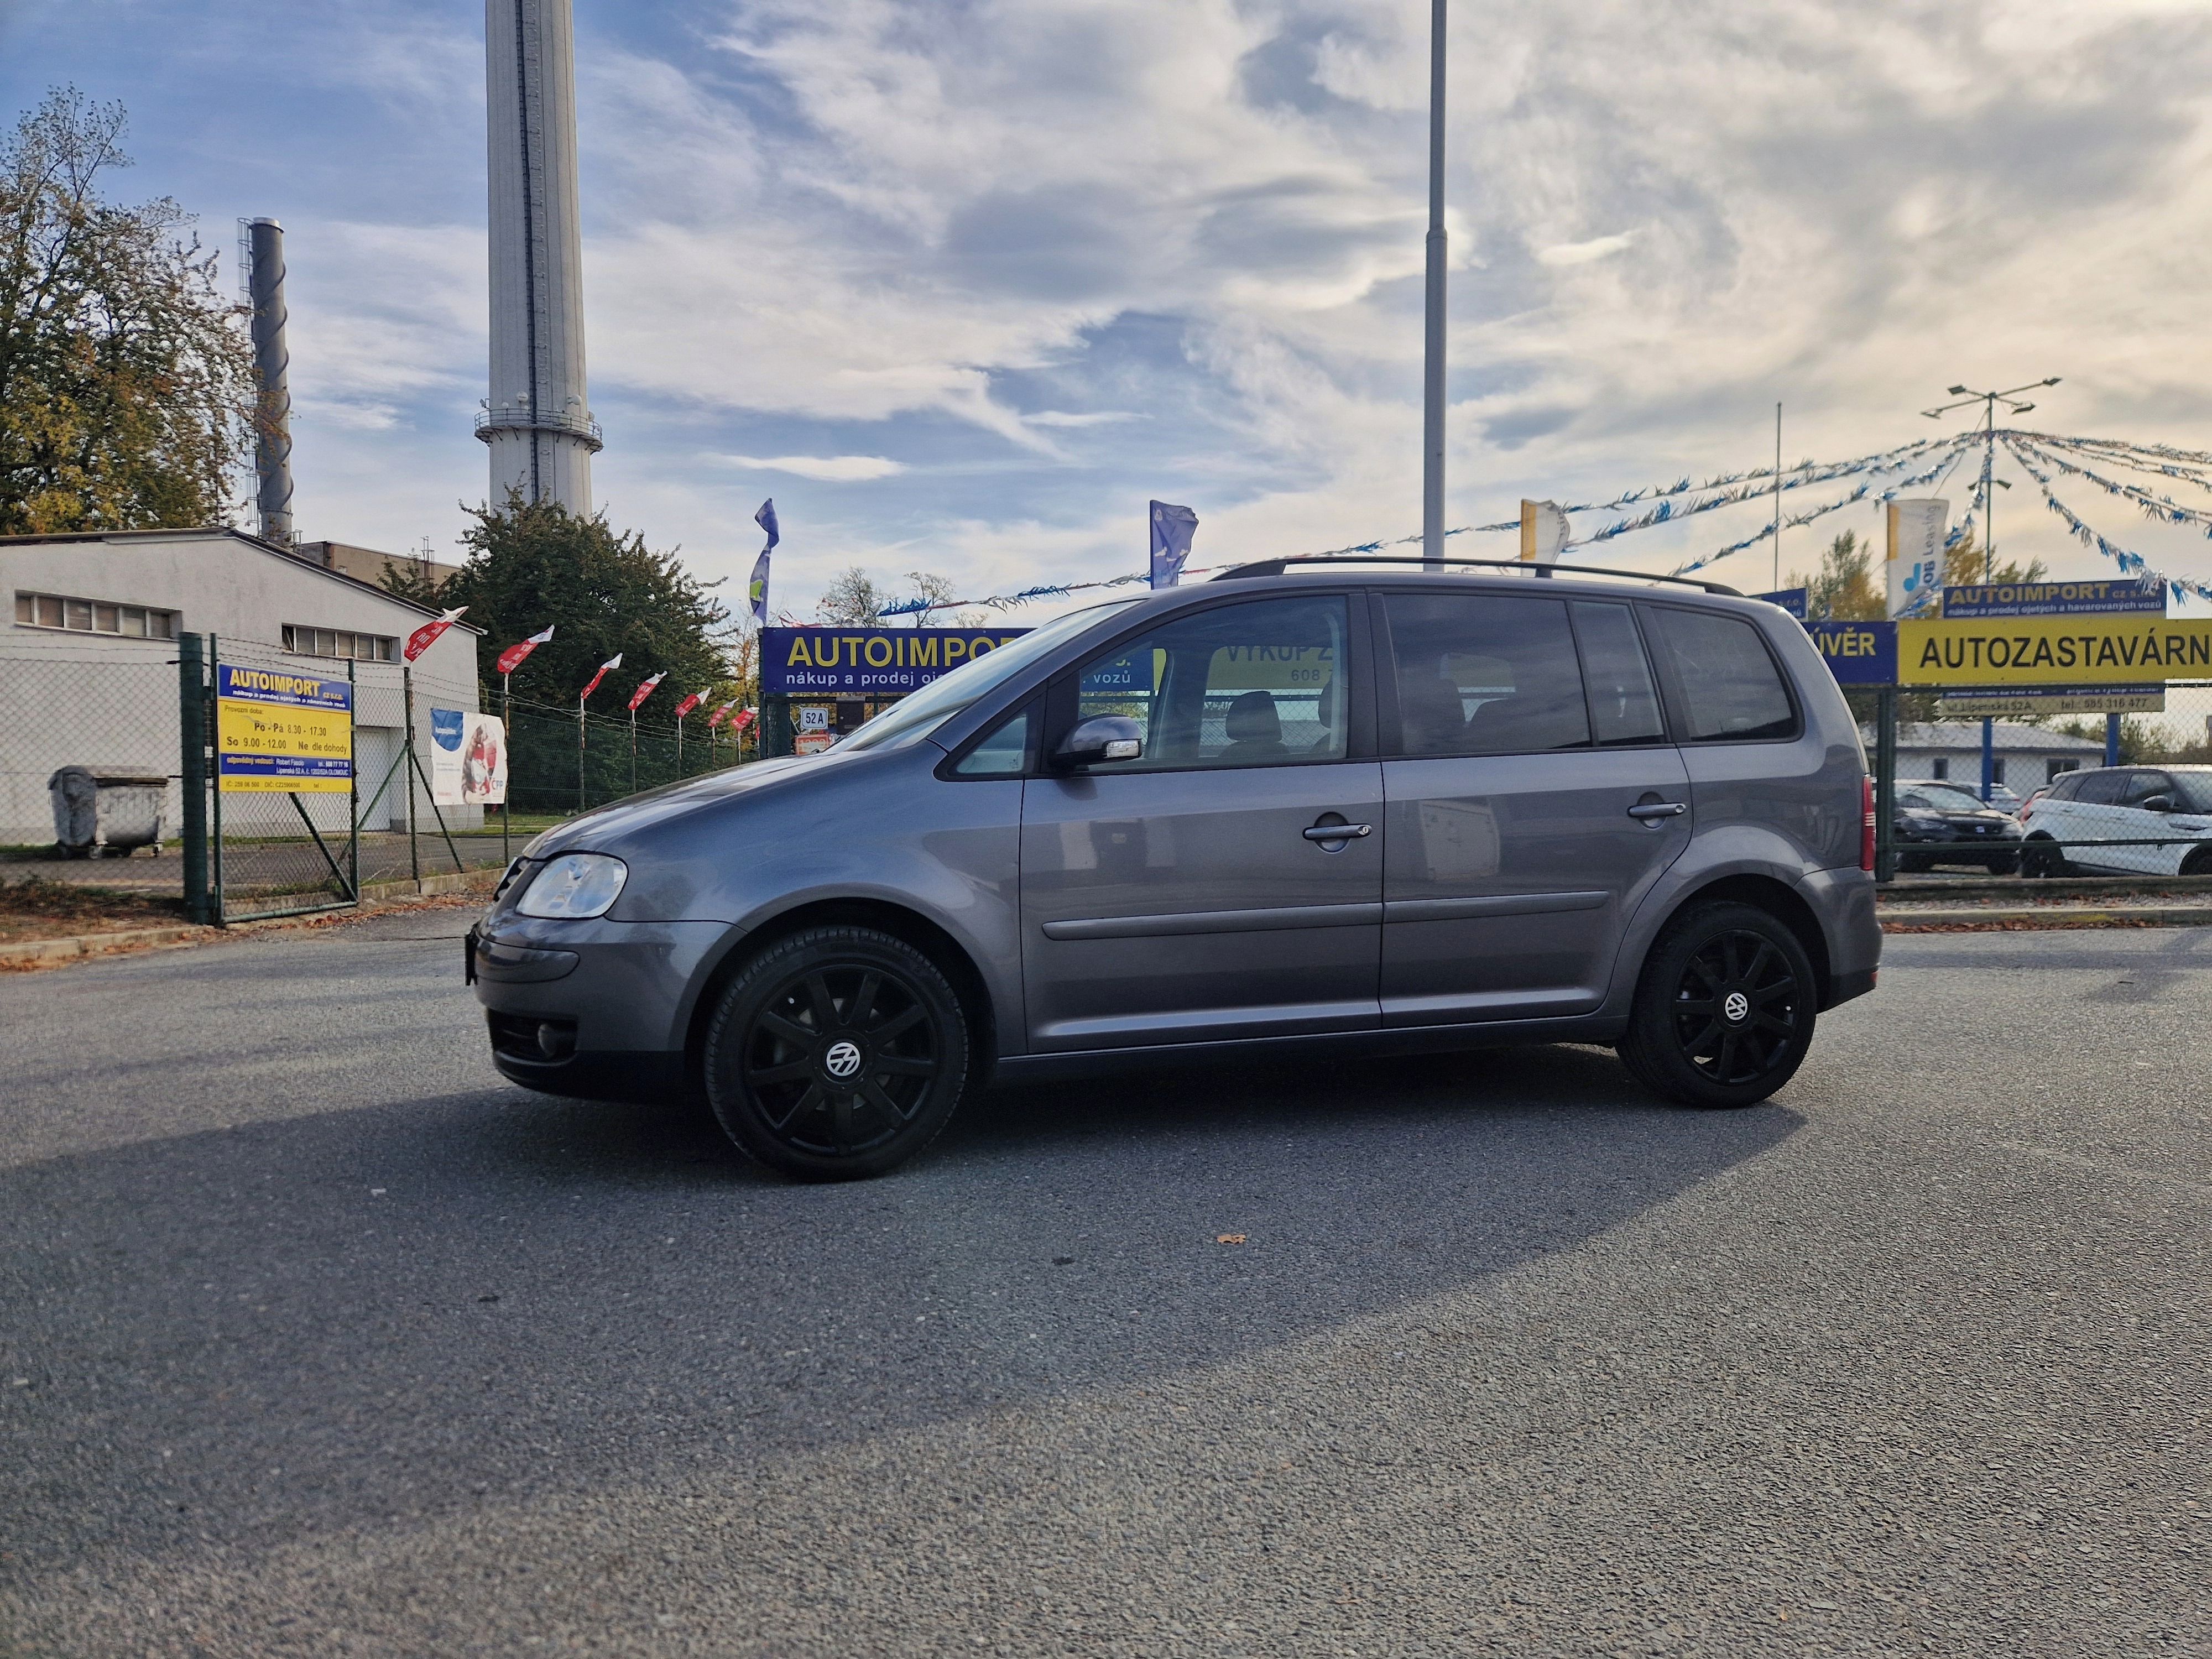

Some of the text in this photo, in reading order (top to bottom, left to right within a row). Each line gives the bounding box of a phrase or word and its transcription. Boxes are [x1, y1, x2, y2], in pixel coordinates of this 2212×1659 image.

[1948, 582, 2110, 605] AUTOIMPORT
[2067, 600, 2136, 612] havarovaných
[786, 637, 1018, 667] AUTOIMPO
[1919, 627, 2210, 668] AUTOZASTAVÁRN
[229, 668, 321, 697] AUTOIMPORT
[786, 671, 838, 687] nákup
[845, 674, 854, 685] a
[861, 671, 915, 687] prodej
[1093, 670, 1130, 684] vozů
[1291, 669, 1320, 681] 608
[806, 712, 824, 724] 52 A
[254, 721, 265, 732] Po
[273, 722, 284, 733] Pá
[287, 724, 302, 735] 8.30
[310, 726, 327, 736] 17.30
[226, 735, 239, 747] So
[243, 738, 260, 748] 9.00
[268, 739, 286, 749] 12.00
[298, 740, 309, 750] Ne
[312, 742, 322, 752] dle
[324, 742, 347, 755] dohody
